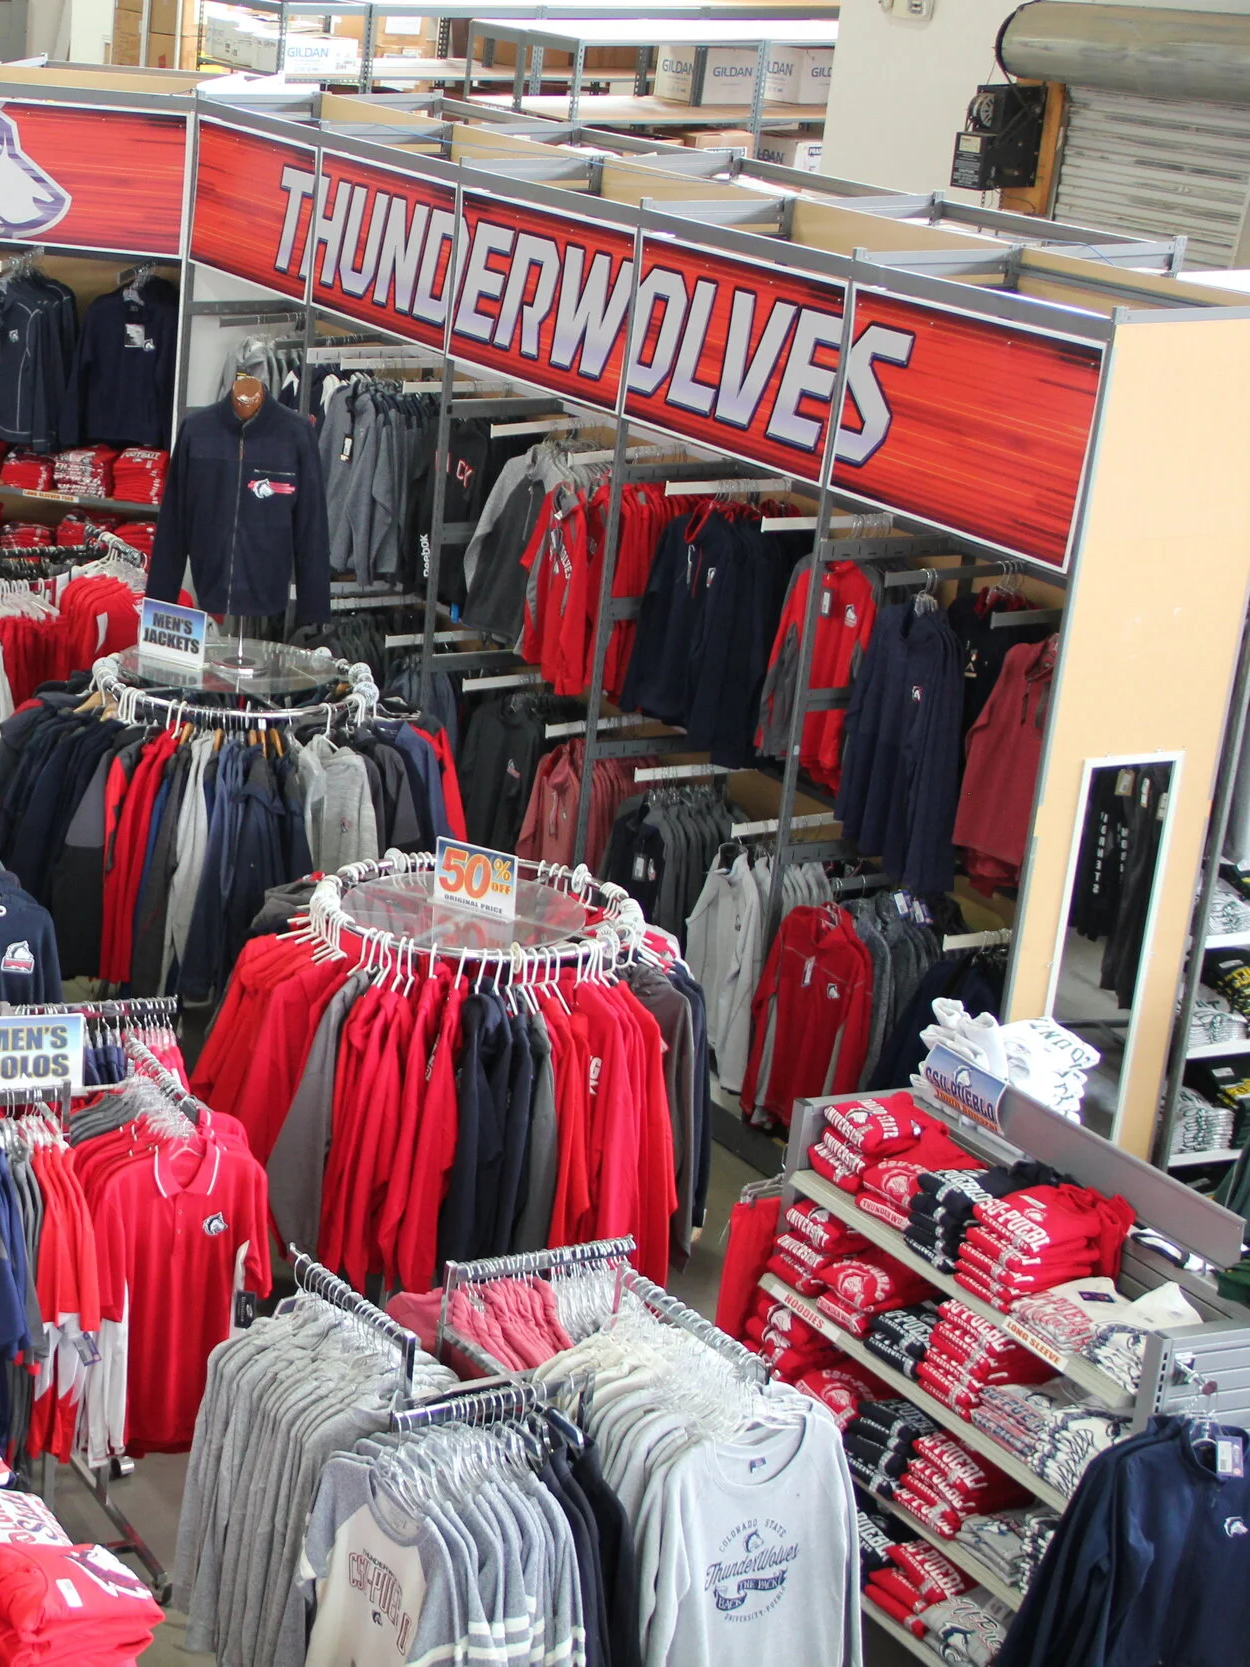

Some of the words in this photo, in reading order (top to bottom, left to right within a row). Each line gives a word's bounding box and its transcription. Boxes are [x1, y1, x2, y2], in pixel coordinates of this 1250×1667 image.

[287, 47, 328, 58] GILDAN
[713, 66, 753, 77] GILDAN
[273, 163, 916, 468] THUNDERWOLVES
[152, 611, 193, 636] MEN'S
[143, 627, 200, 655] JACKETS
[491, 882, 511, 895] OFF
[480, 902, 503, 915] PRICE
[784, 1293, 825, 1330] HOODIES
[1006, 1320, 1028, 1342] LONG
[1029, 1338, 1061, 1365] SLEEVE
[718, 1518, 758, 1553] COLORADO
[764, 1518, 787, 1538] STATE
